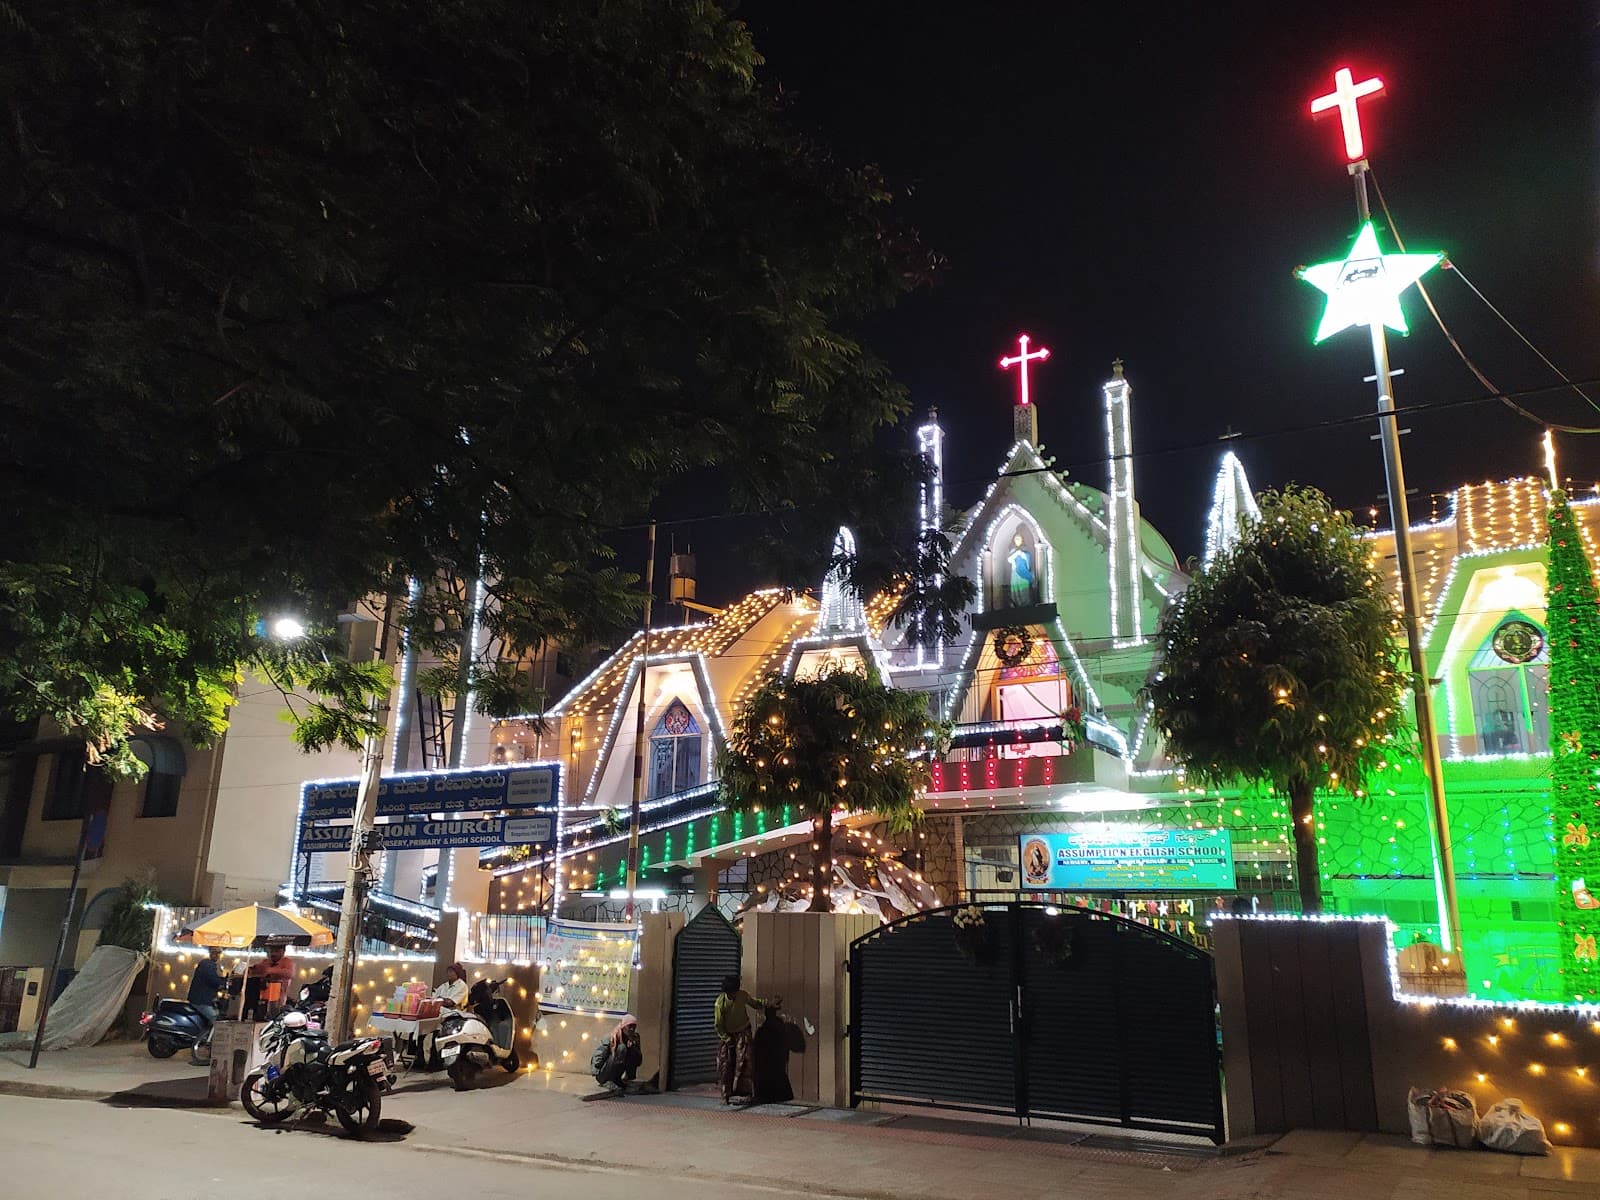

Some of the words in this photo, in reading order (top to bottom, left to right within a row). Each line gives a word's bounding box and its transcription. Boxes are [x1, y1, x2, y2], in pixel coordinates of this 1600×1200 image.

[423, 820, 502, 836] CHURCH
[409, 837, 441, 846] PRIMARY
[450, 836, 468, 844] HIGH
[470, 835, 501, 843] SCHOOL
[1058, 848, 1127, 858] ASSUMPTION
[1130, 847, 1175, 857] ENGLISH
